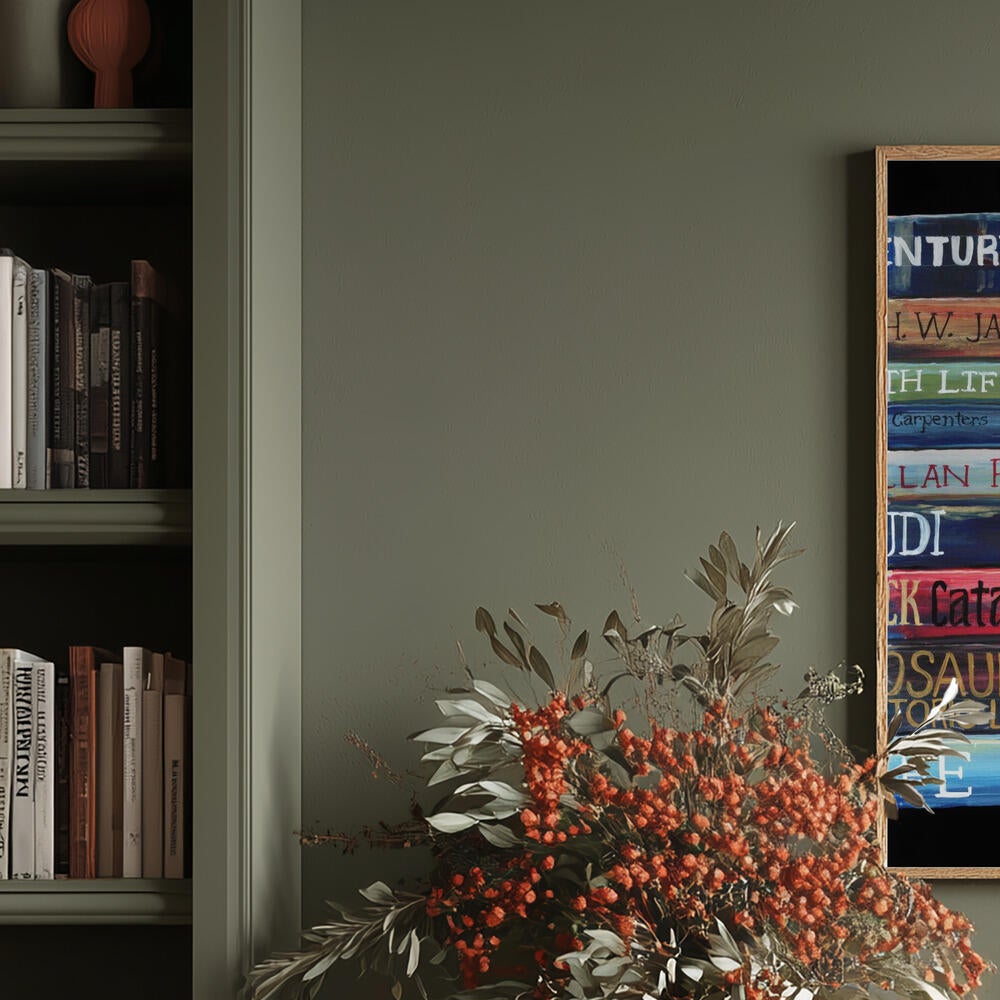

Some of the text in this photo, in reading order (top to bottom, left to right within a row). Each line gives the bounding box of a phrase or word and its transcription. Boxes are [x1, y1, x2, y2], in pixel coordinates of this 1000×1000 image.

[914, 311, 953, 341] W.
[891, 411, 989, 433] Carpenters
[888, 464, 970, 489] LAN
